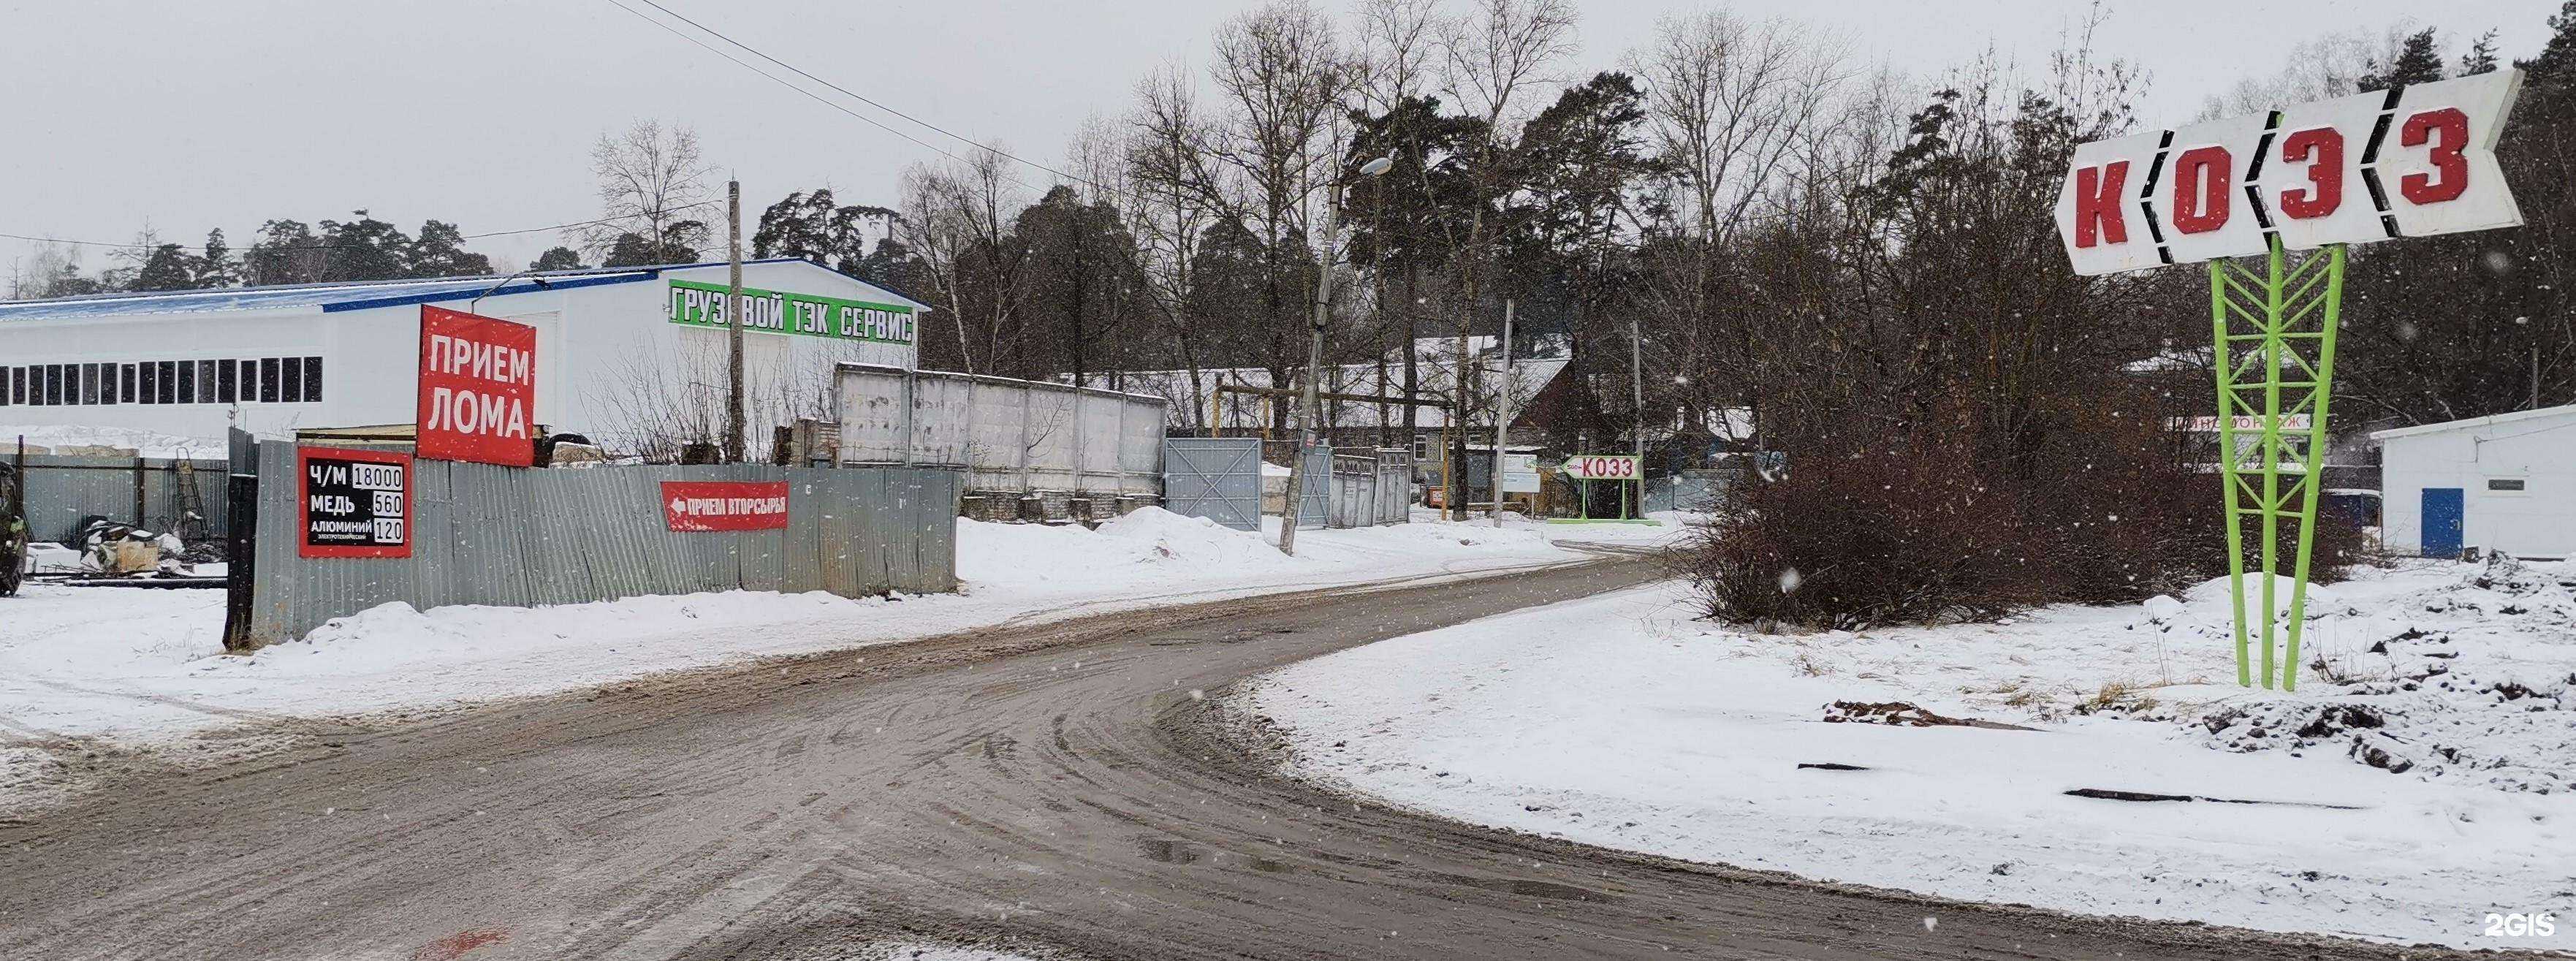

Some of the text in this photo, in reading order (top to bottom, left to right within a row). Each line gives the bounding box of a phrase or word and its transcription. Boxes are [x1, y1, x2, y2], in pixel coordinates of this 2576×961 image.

[2075, 107, 2469, 248] КОЭЗ
[792, 300, 830, 335] ТЭК
[840, 306, 913, 342] СЕРВИС
[430, 334, 529, 386] ПРИЕМ
[428, 387, 526, 440] ЛОМА
[310, 465, 402, 487] Ч/М 18000
[1582, 457, 1633, 476] КОЭЗ
[311, 494, 402, 516] МЕДЬ 560
[687, 496, 786, 515] ПРИЕМ ВТОРСЫРЬЯ
[311, 520, 402, 540] АЛЮМИНИЙ 120
